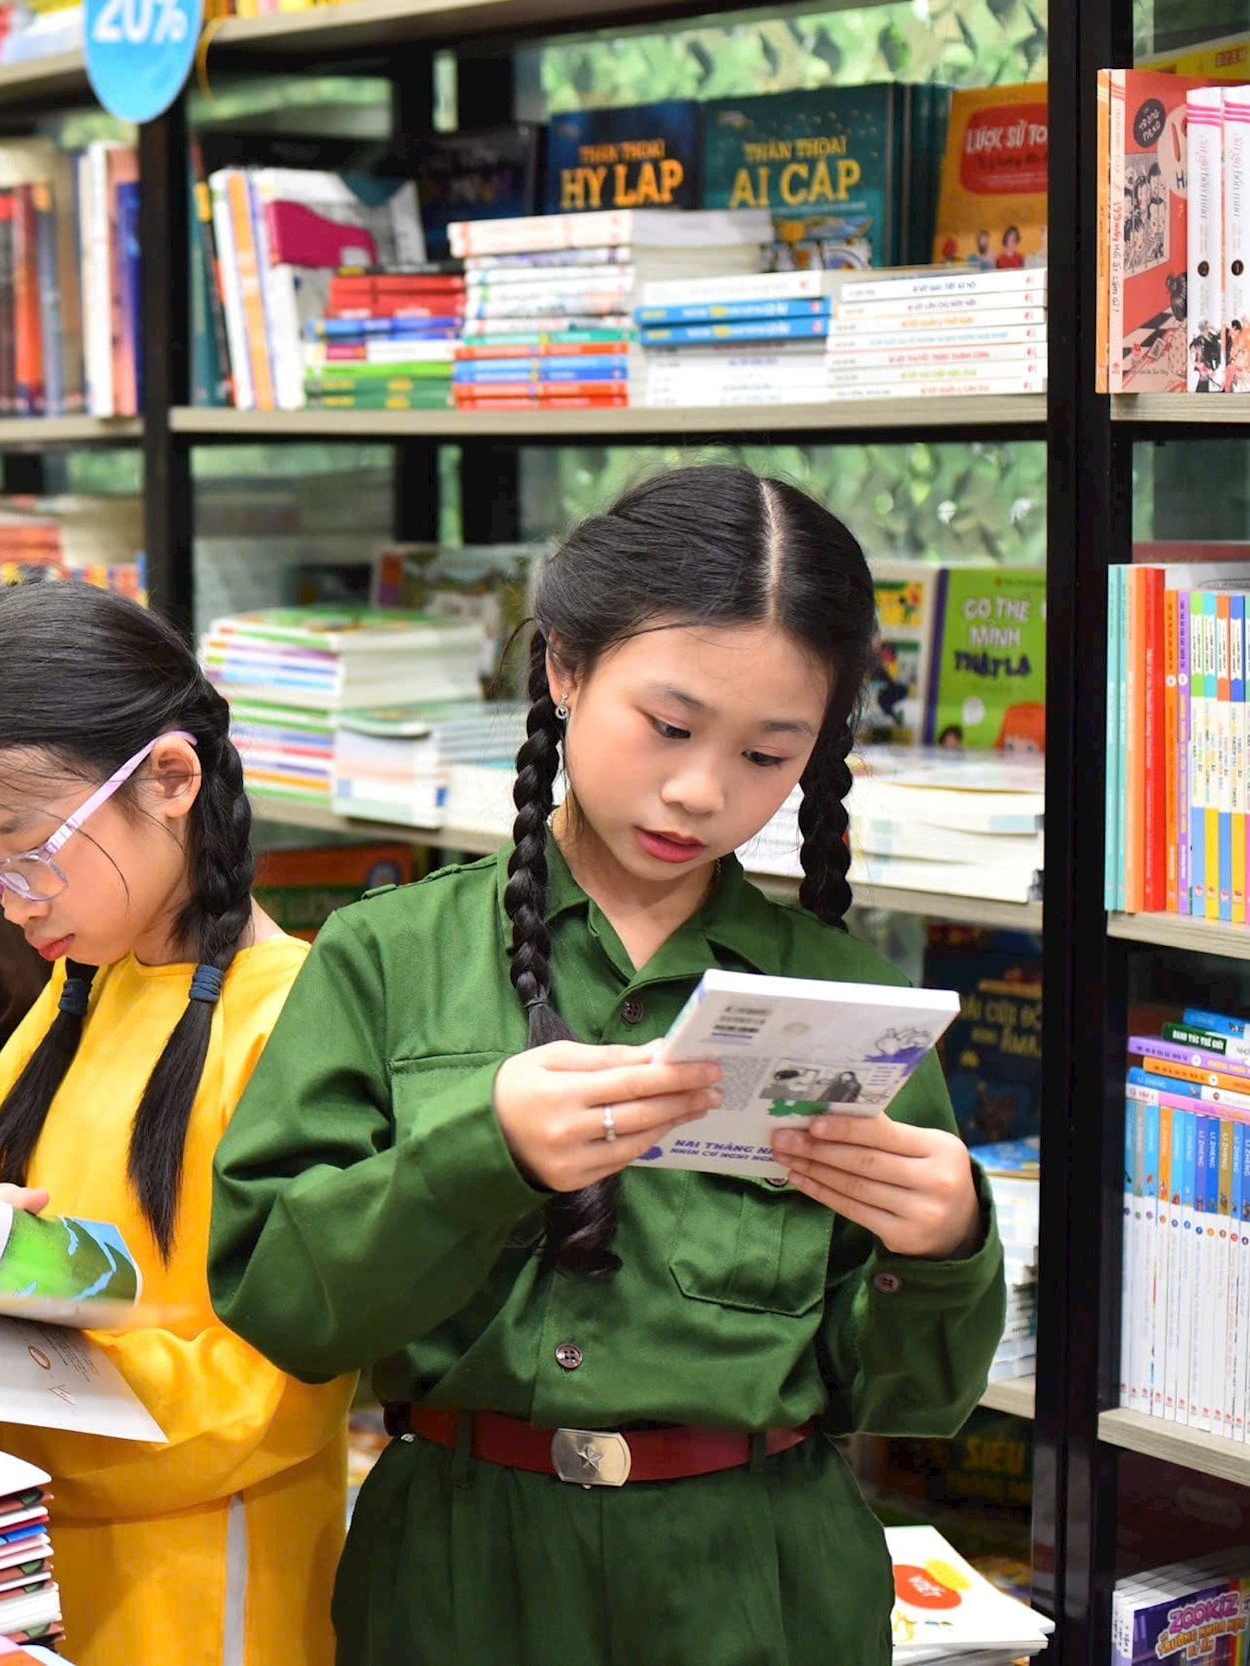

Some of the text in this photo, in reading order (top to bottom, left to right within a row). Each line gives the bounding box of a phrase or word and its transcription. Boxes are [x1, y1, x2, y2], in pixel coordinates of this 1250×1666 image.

[561, 166, 607, 210] HY
[729, 167, 770, 209] AI
[675, 1139, 755, 1155] HAI THẰNG
[1169, 1593, 1239, 1635] ZOOKIZ
